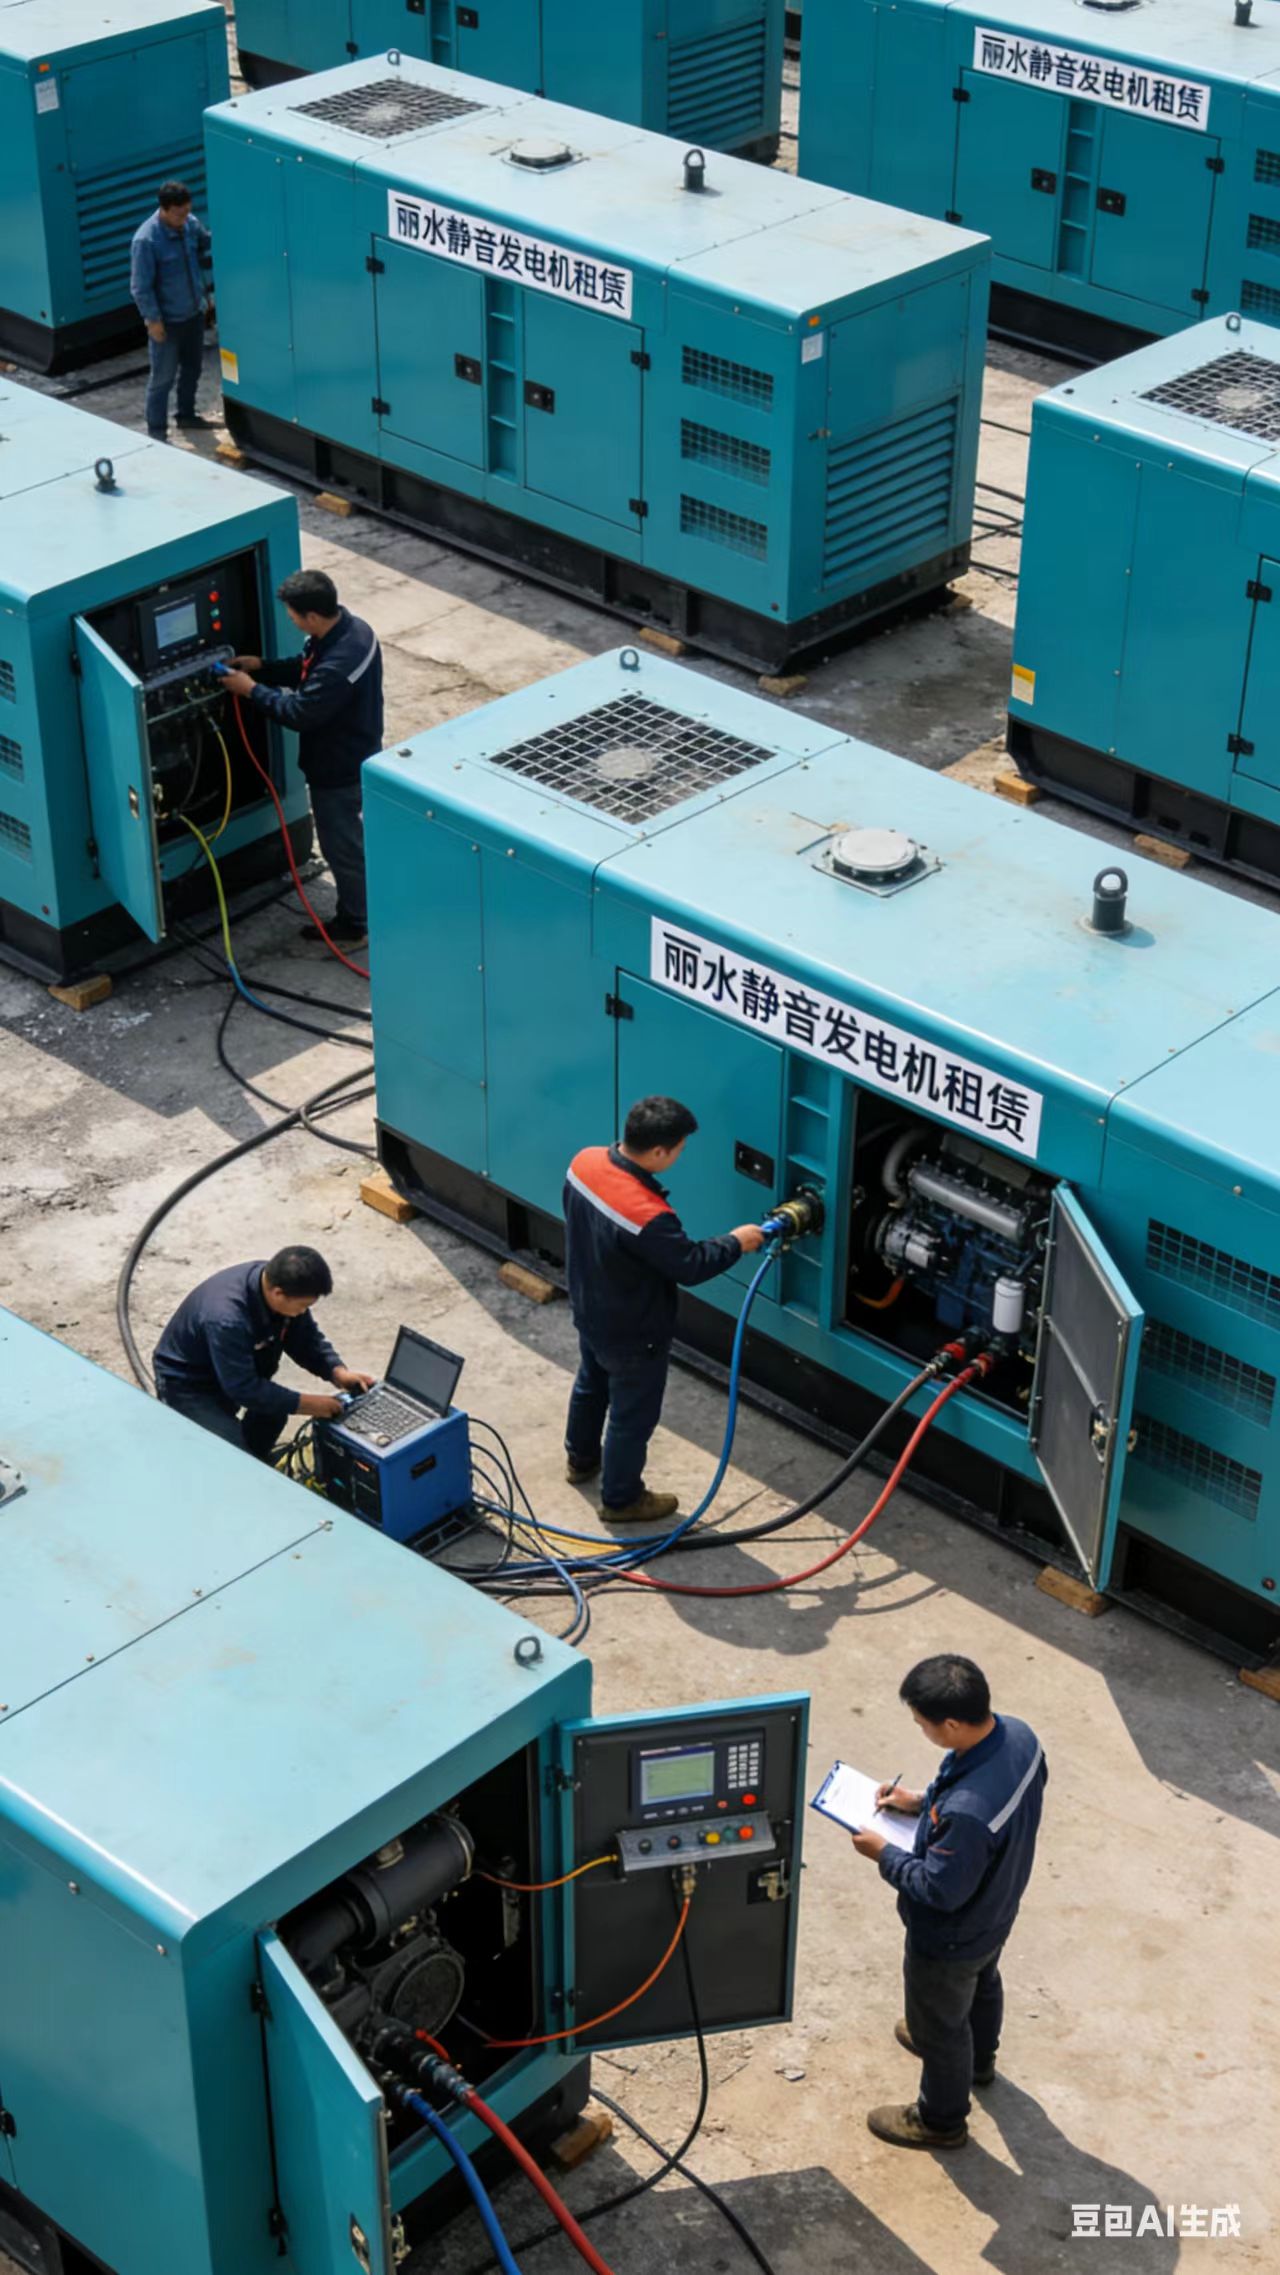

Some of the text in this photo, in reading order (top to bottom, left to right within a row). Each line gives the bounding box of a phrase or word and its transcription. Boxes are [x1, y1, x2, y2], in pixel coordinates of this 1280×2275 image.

[981, 34, 1203, 122] 丽水静音发电机租赁
[395, 200, 626, 309] 丽水静音发电机租赁
[662, 932, 1030, 1142] 丽水静音发电机租赁
